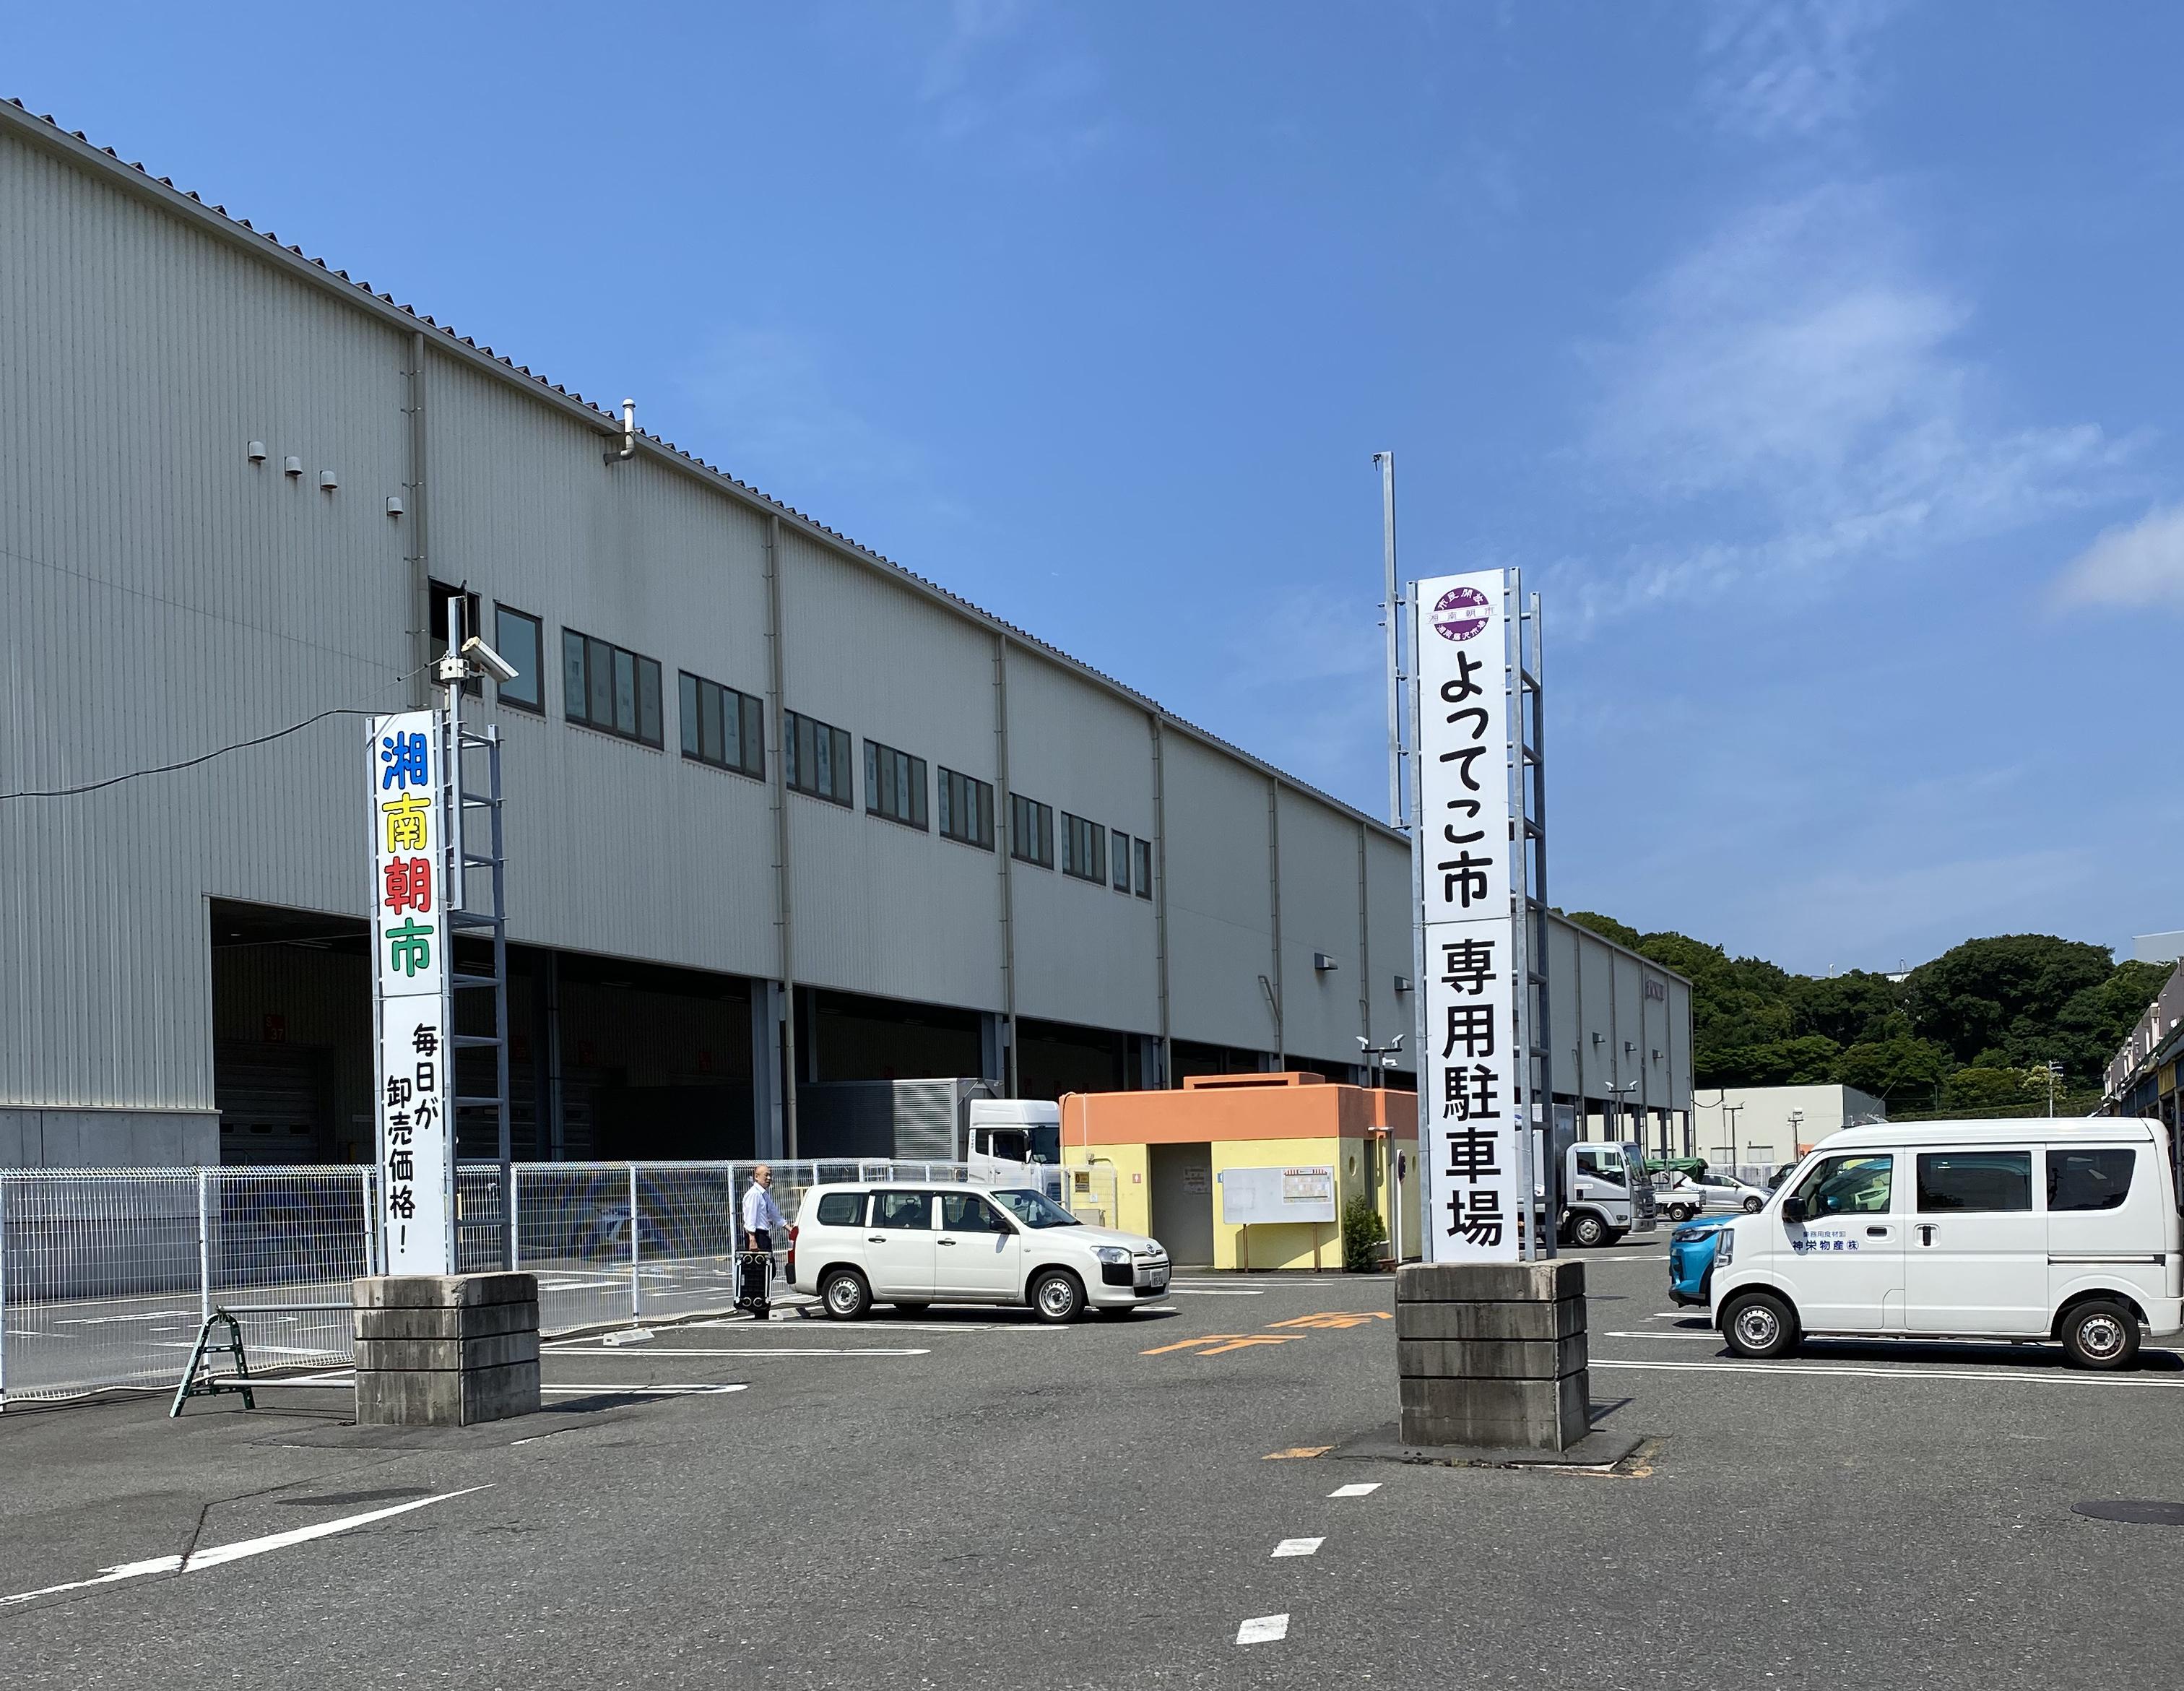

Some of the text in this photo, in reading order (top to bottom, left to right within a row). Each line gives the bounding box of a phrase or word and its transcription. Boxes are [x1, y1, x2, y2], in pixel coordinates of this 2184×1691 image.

[381, 730, 435, 978] 湘南朝市
[412, 1022, 439, 1130] 毎日が
[1441, 938, 1504, 1247] 専用駐車場
